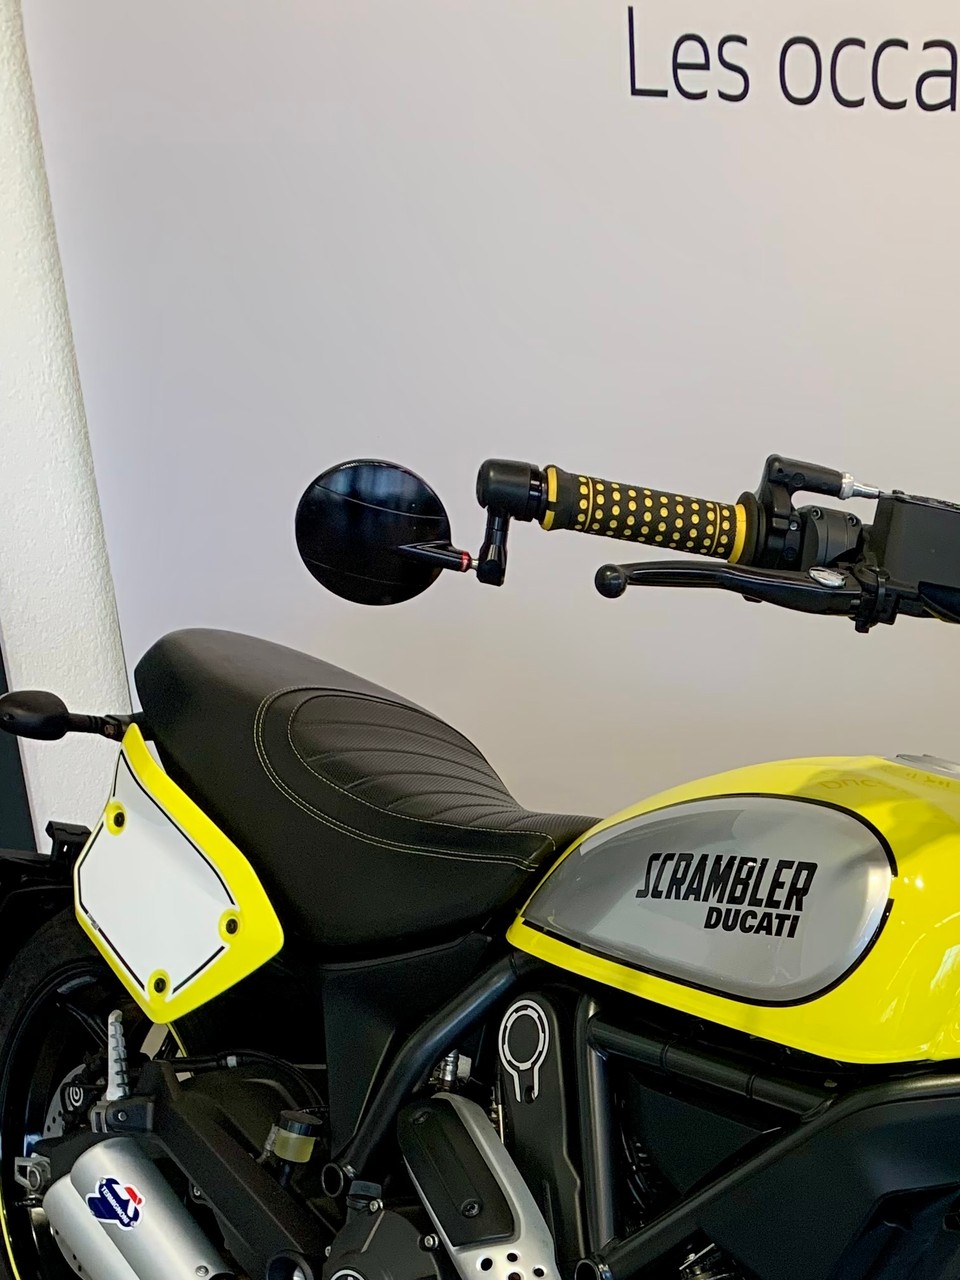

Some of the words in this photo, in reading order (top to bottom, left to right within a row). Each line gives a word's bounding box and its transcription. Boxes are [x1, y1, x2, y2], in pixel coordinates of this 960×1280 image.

[627, 5, 750, 103] Les
[635, 852, 819, 912] SCRAMBLER
[703, 906, 801, 939] DUCATI
[101, 1186, 131, 1224] TERMIGNONI
